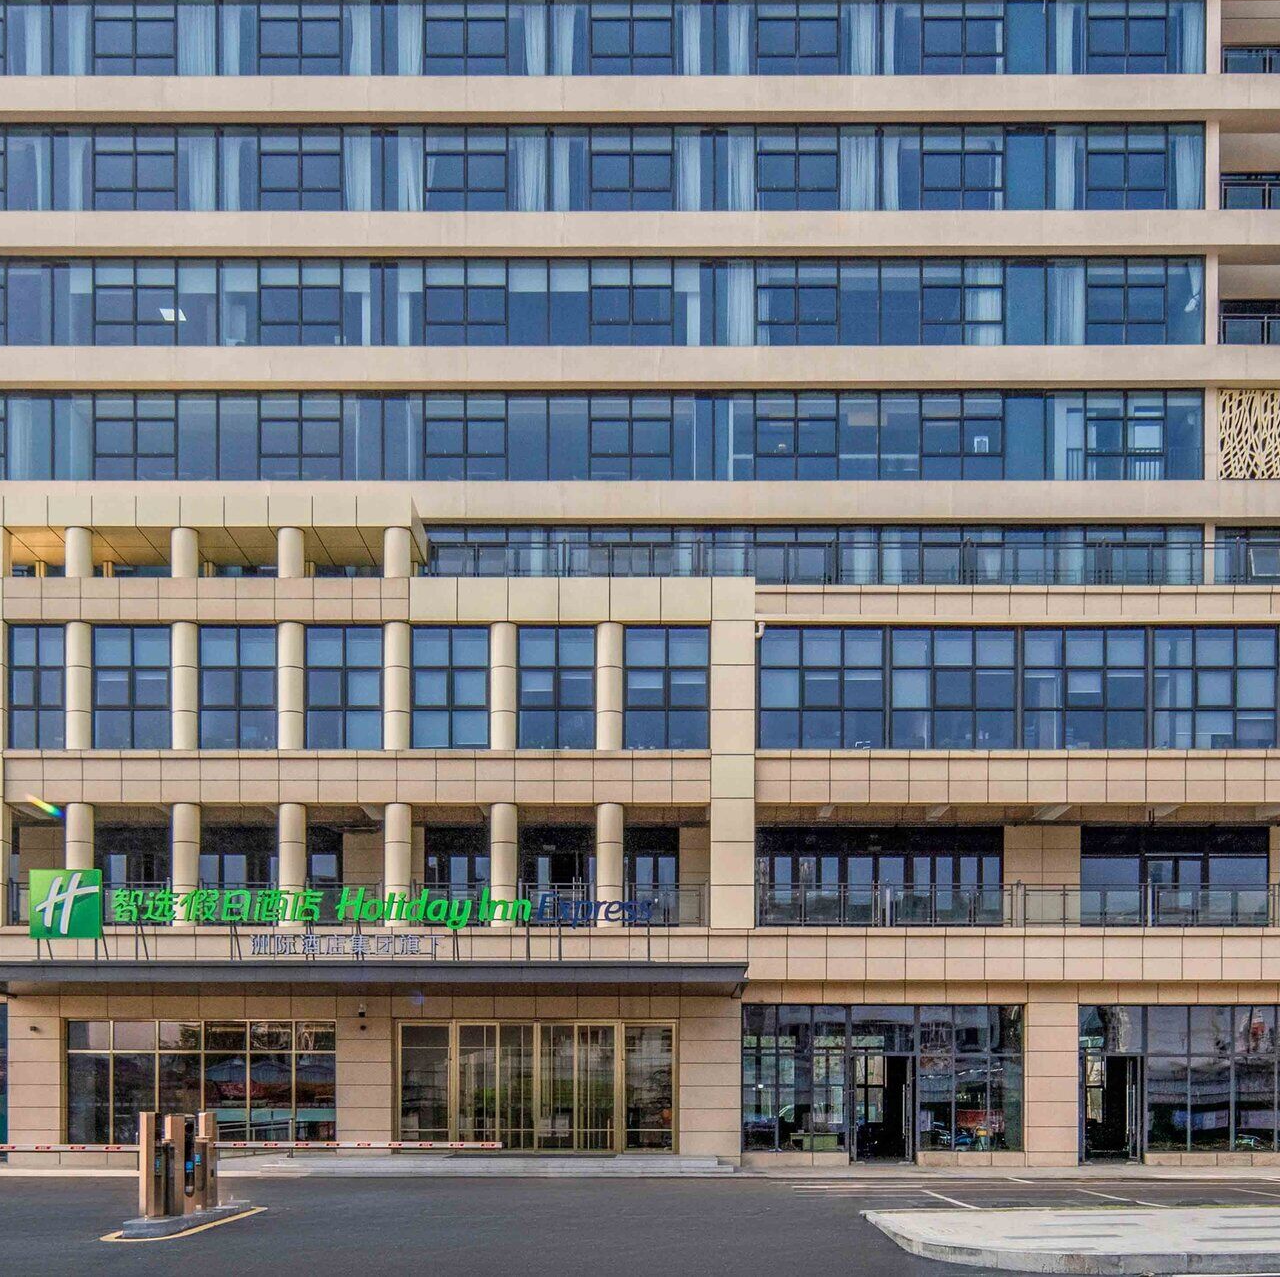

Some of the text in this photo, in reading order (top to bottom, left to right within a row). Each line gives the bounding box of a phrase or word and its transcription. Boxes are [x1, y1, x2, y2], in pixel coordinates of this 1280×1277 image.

[112, 887, 653, 930] 智选假日酒店 Holiday Inn Express
[250, 933, 446, 956] 洲际酒店集团旗下
